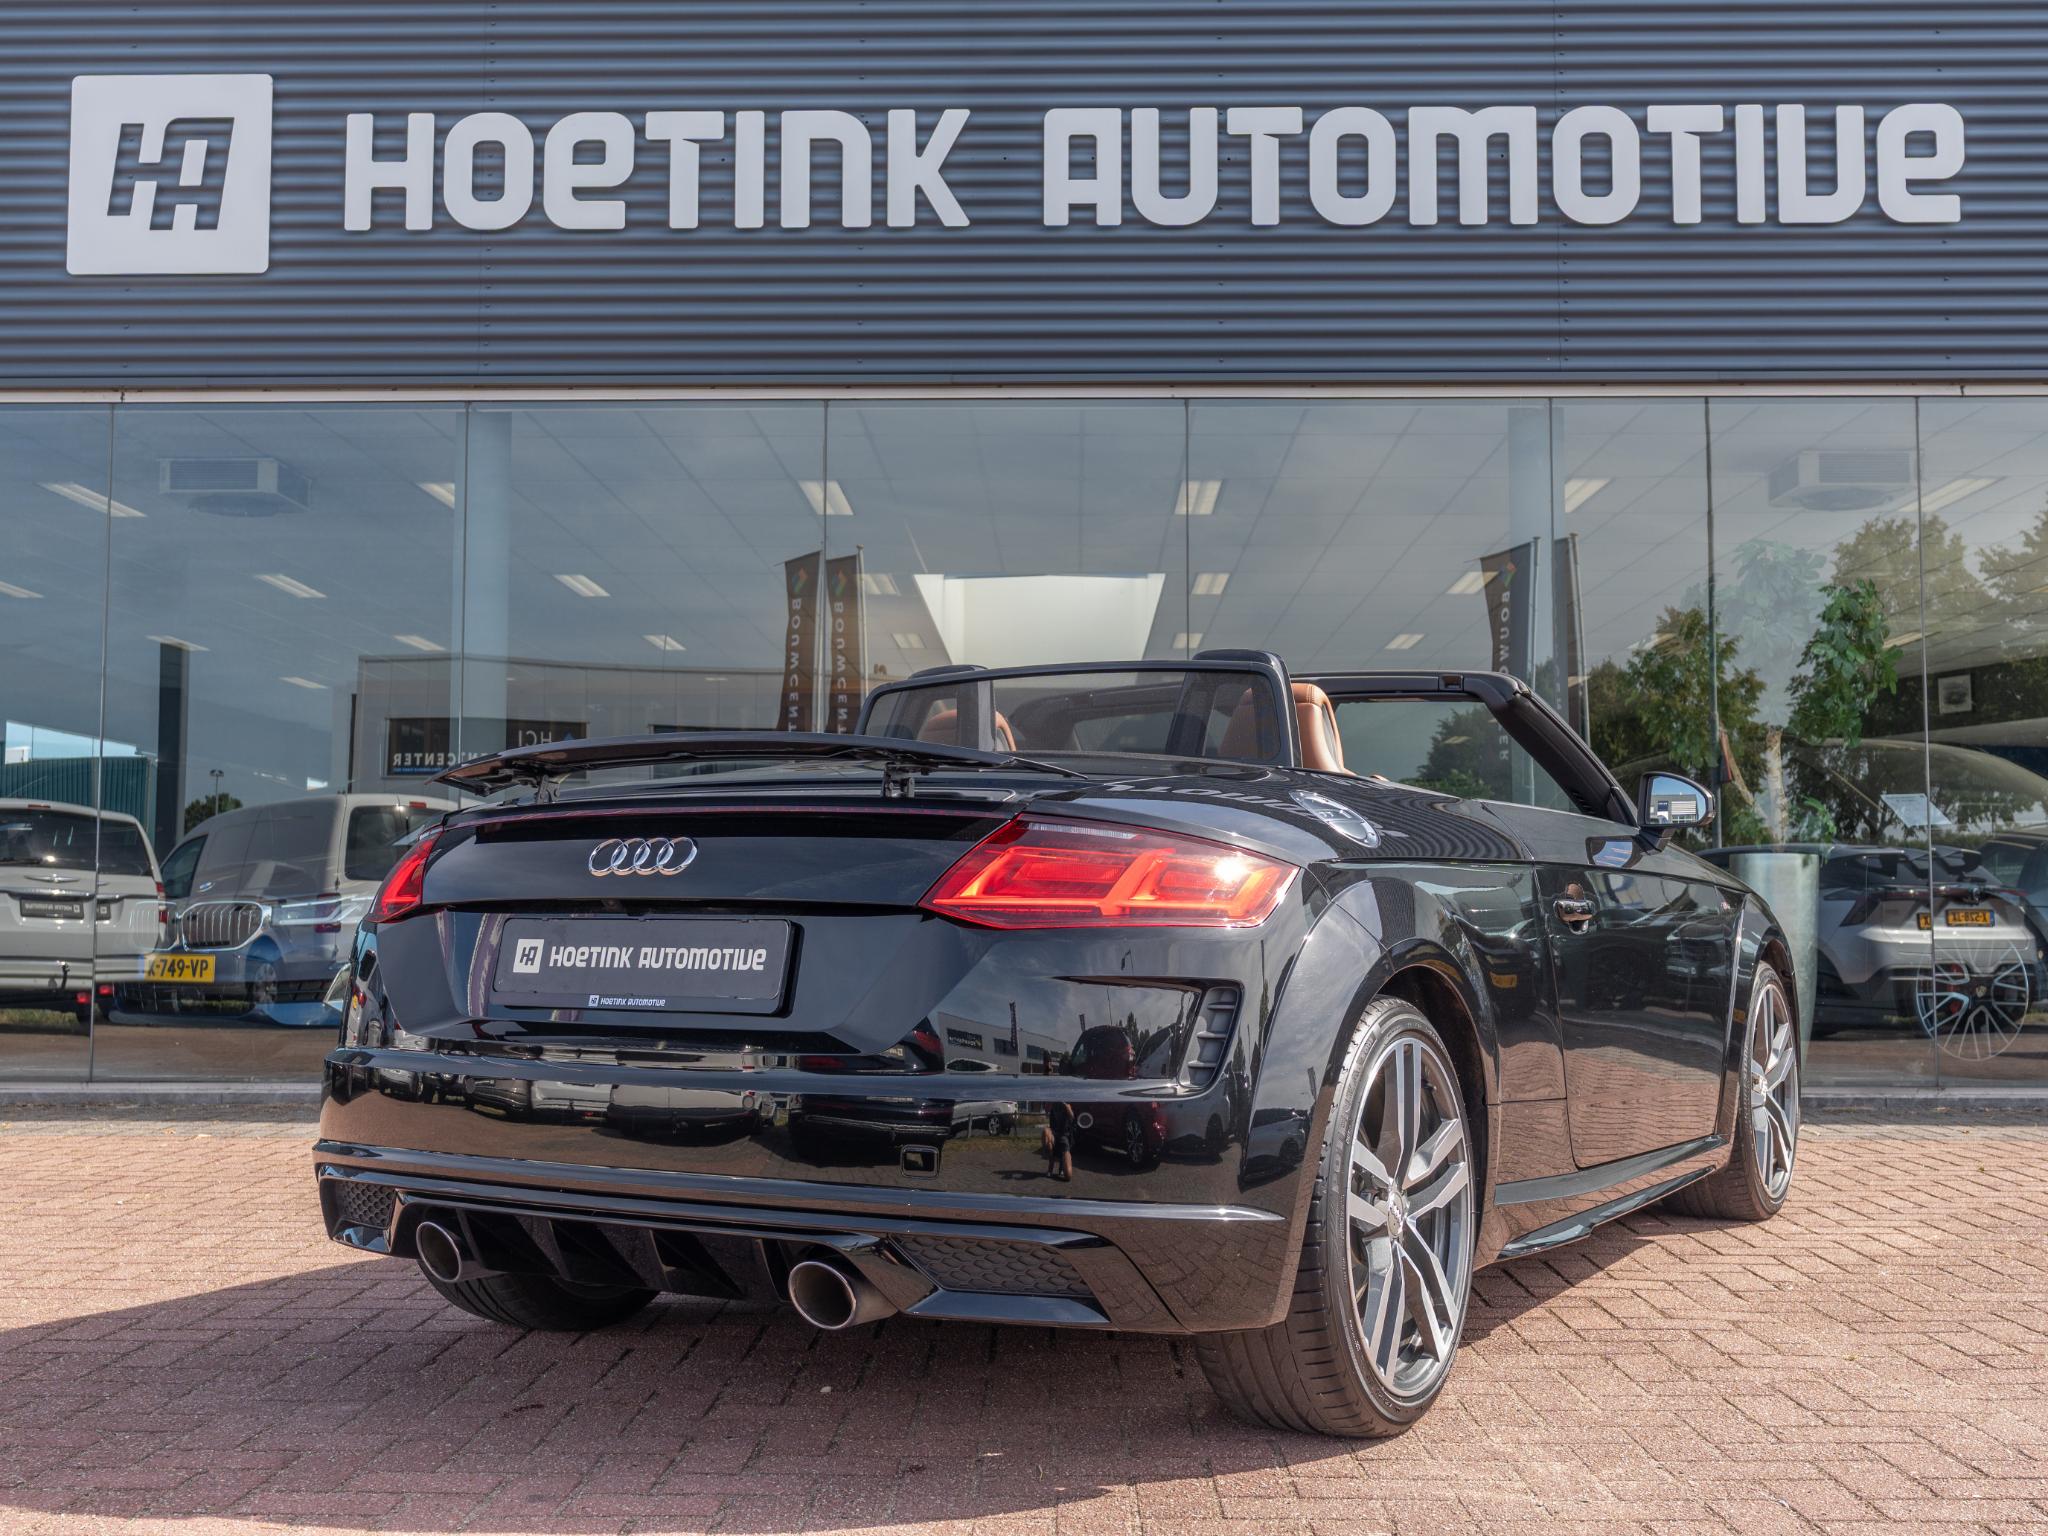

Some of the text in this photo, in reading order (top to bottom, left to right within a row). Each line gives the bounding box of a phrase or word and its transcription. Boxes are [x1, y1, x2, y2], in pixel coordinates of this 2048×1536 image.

[344, 103, 1965, 231] HOETINK AUTOMOTIVE
[549, 945, 767, 971] HOETINK AUTOMOTIVE
